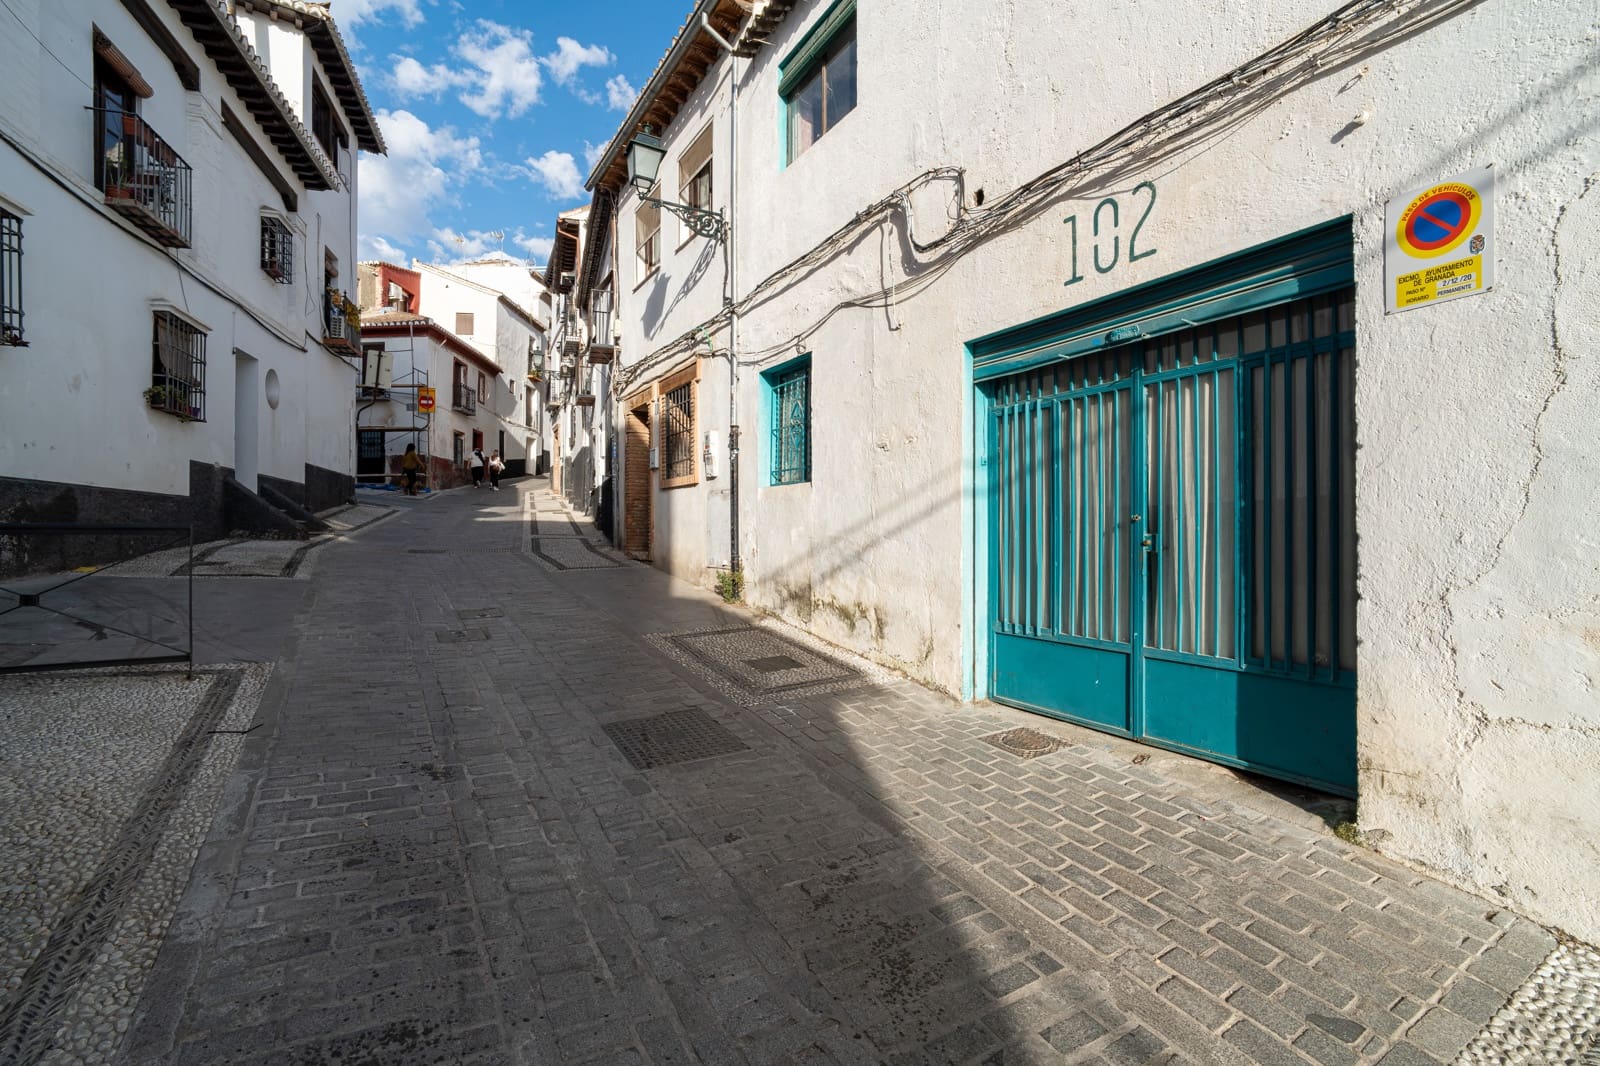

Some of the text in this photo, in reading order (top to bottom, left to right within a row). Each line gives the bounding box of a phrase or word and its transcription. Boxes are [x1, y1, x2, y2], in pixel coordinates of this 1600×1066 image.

[1402, 202, 1418, 221] PASO
[1419, 193, 1430, 202] DE
[1063, 181, 1157, 286] 102
[1425, 259, 1474, 276] AYUNTAMIENTO
[1413, 271, 1455, 287] DE GRANADA
[1406, 288, 1419, 296] PASO
[1406, 283, 1472, 304] HORARIO PERMANENTE
